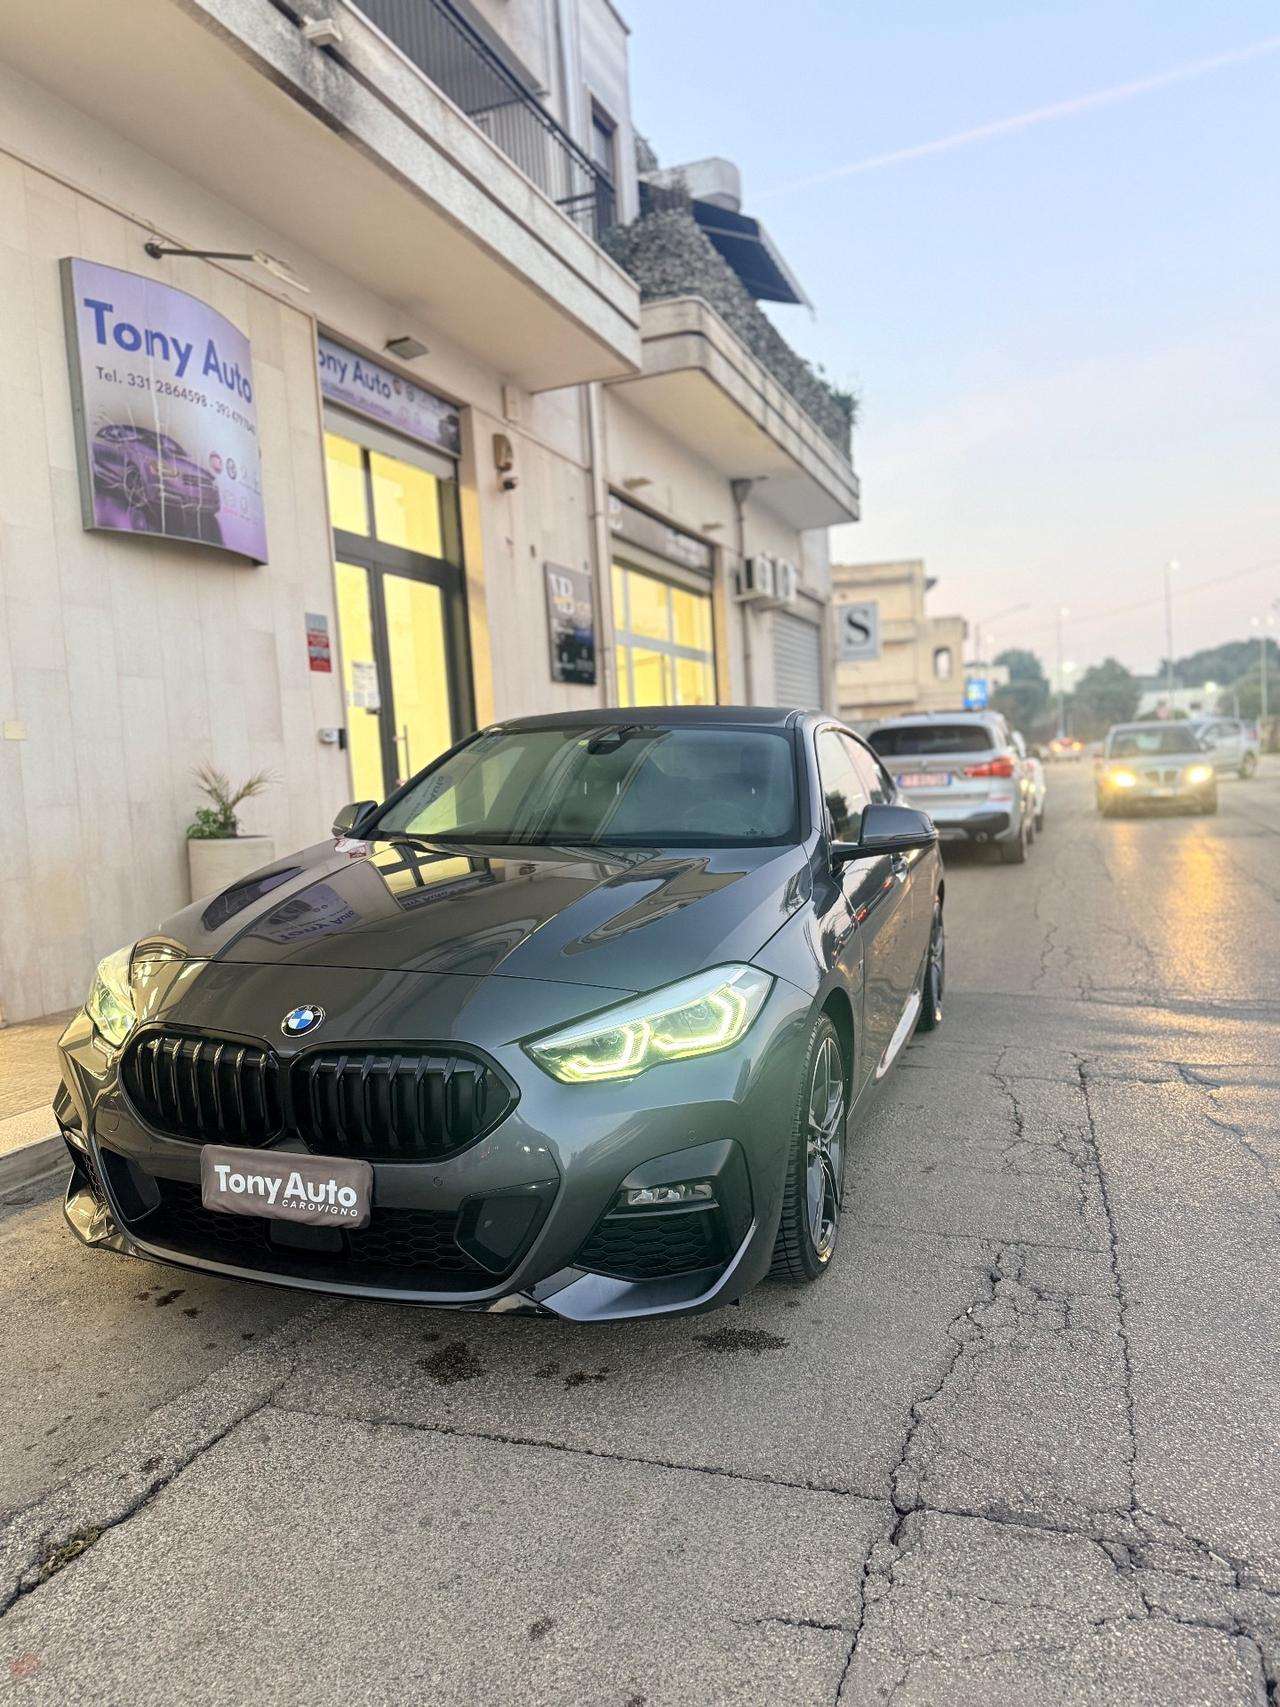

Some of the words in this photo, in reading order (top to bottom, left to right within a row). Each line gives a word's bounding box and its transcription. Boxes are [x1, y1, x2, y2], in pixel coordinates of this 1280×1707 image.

[84, 298, 193, 378] Tony
[202, 338, 252, 404] Auto
[96, 365, 122, 384] Tel.
[127, 373, 151, 391] 331
[352, 360, 391, 399] Auto
[846, 608, 870, 647] S
[281, 1199, 358, 1217] CAROVIGNO
